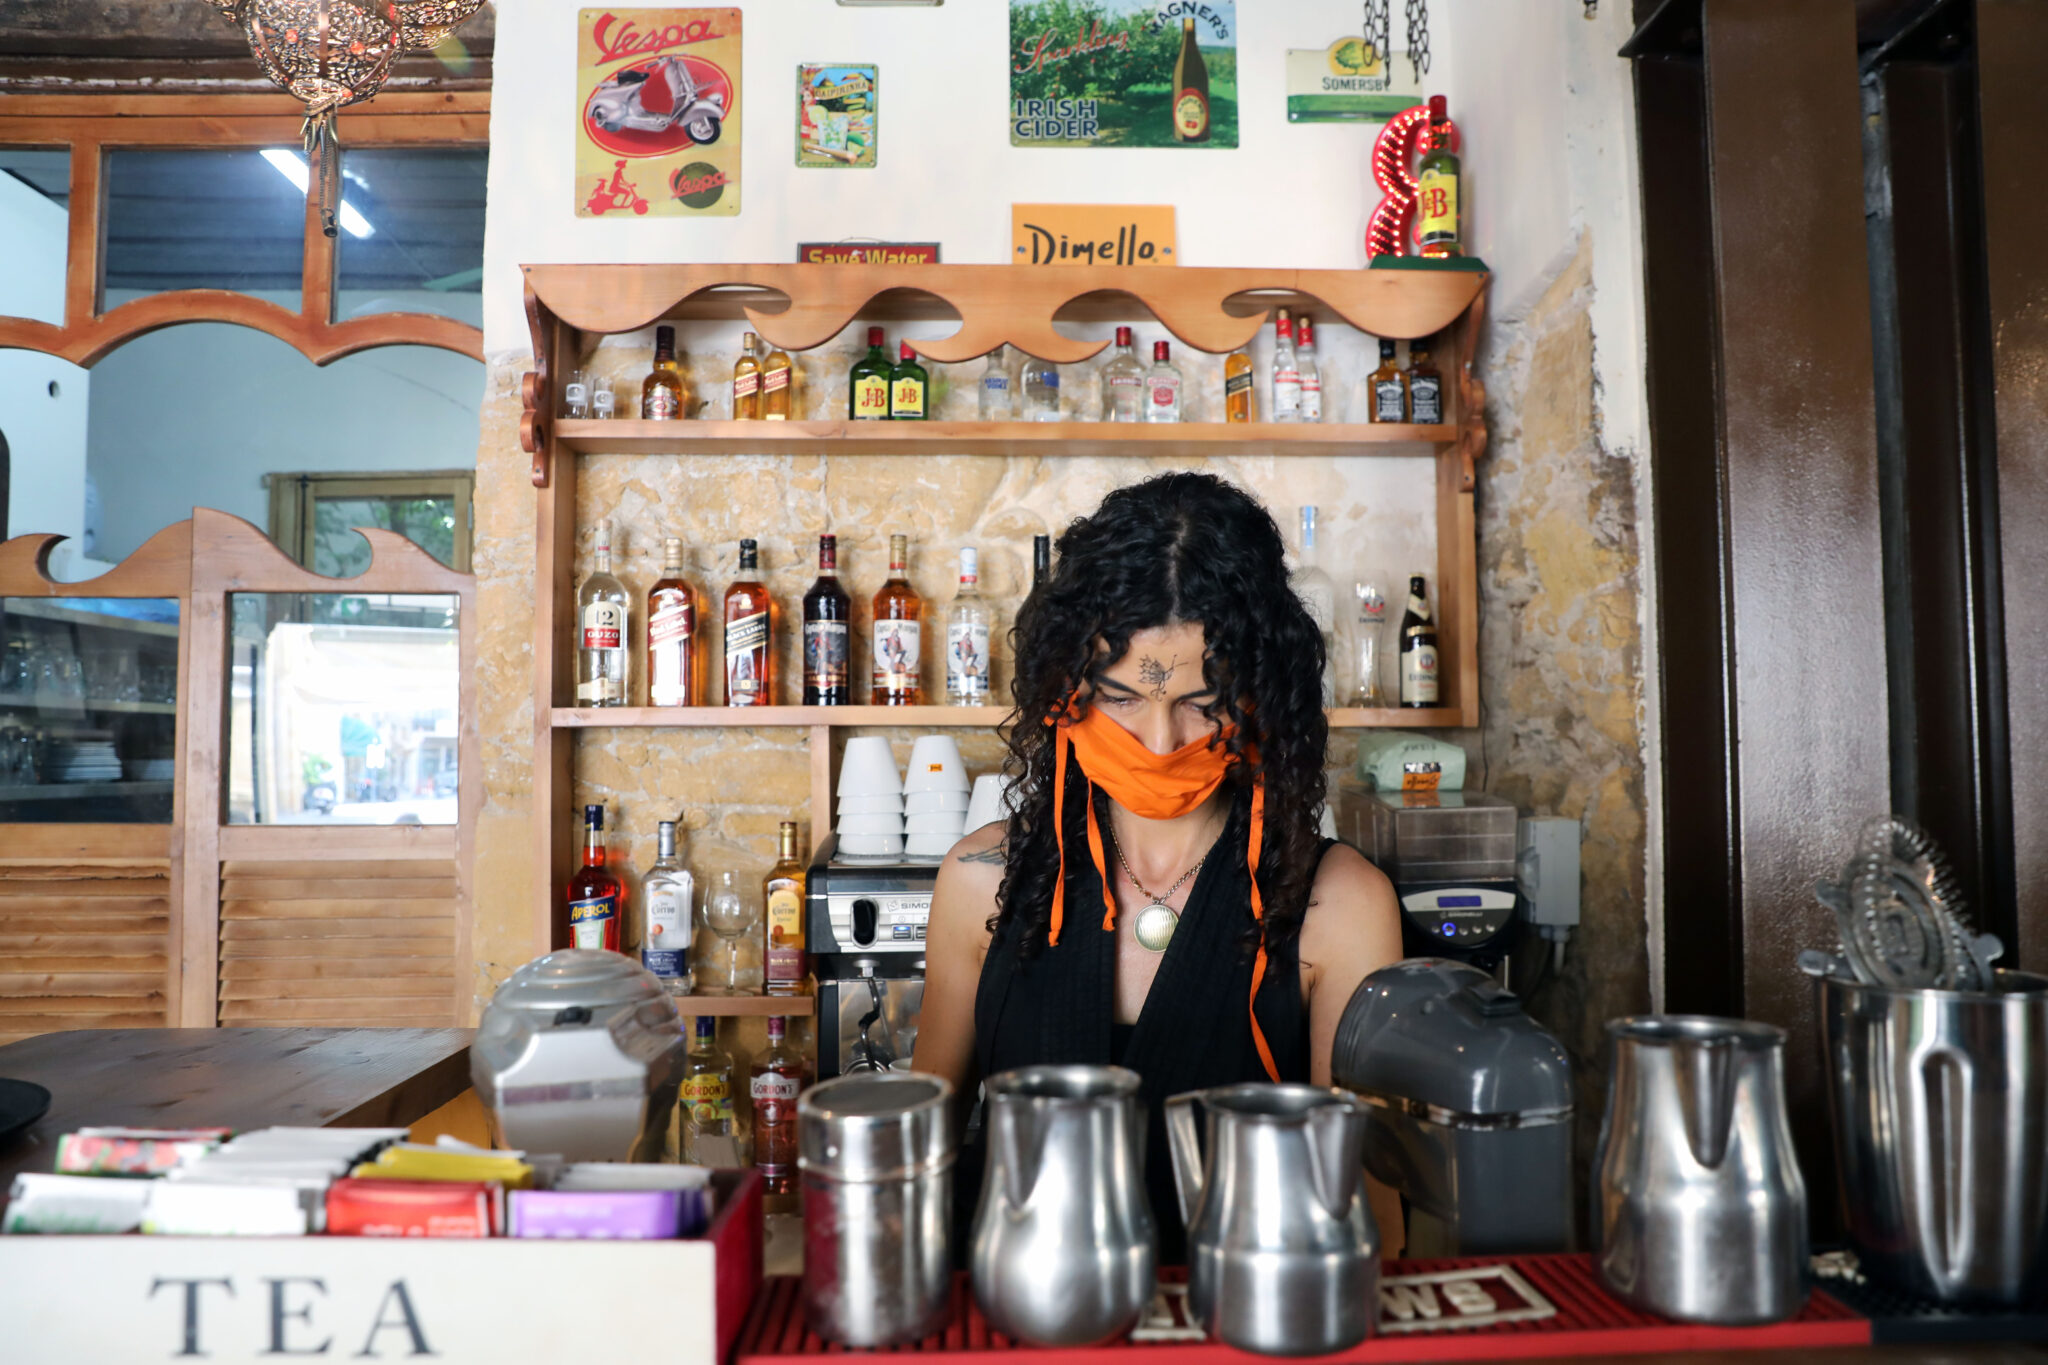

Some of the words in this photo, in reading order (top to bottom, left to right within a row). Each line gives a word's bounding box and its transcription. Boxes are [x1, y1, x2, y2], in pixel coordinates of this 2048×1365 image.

[1149, 1, 1230, 40] MAGNER'S
[593, 12, 724, 66] Vespa
[1014, 18, 1129, 75] Sparkling
[1015, 98, 1099, 119] IRISH
[1014, 119, 1099, 138] CIDER
[669, 167, 732, 199] Vespa
[1023, 223, 1156, 265] Dimello
[587, 631, 619, 639] OUZO
[571, 903, 610, 921] APEROL
[148, 1276, 441, 1359] TEA
